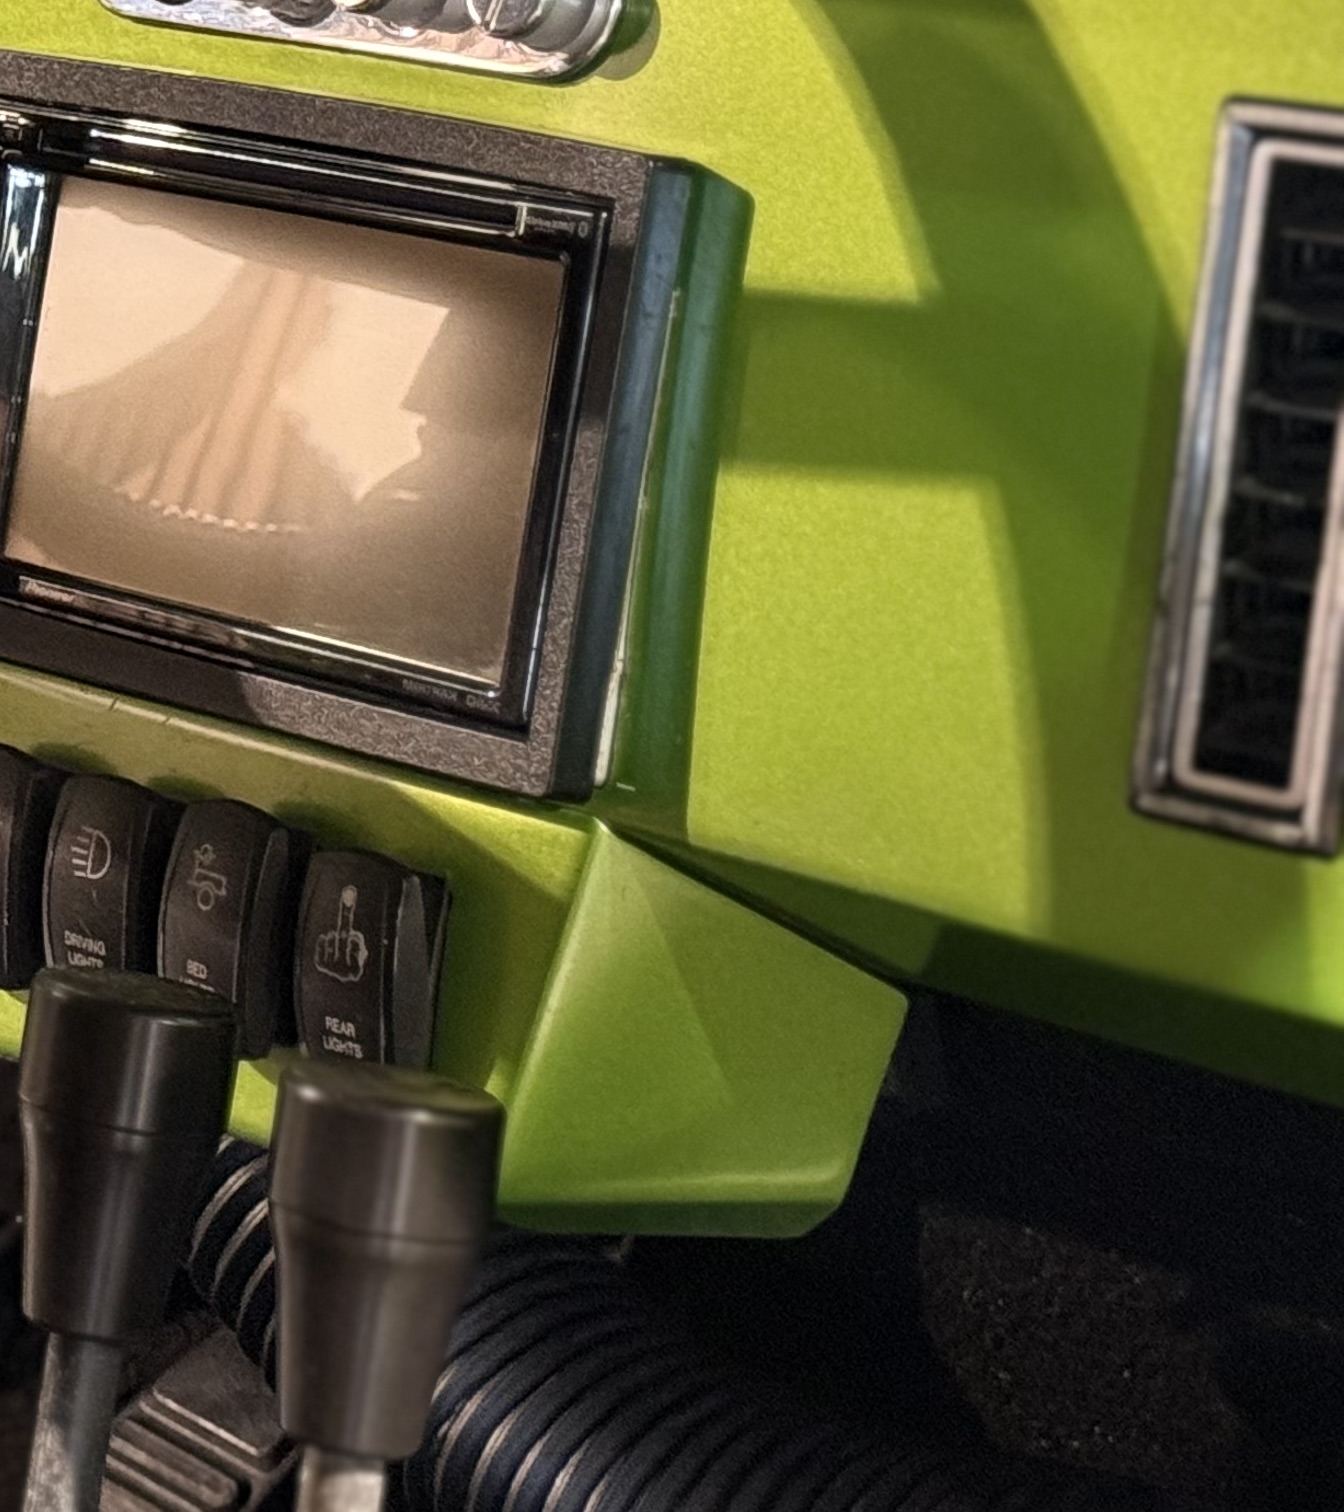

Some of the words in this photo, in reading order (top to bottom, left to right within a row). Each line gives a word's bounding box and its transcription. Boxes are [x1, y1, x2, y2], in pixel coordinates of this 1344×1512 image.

[64, 930, 106, 956] DRIVING
[186, 959, 208, 979] BED
[324, 1016, 356, 1039] REAR
[322, 1035, 363, 1059] LIGHTS
